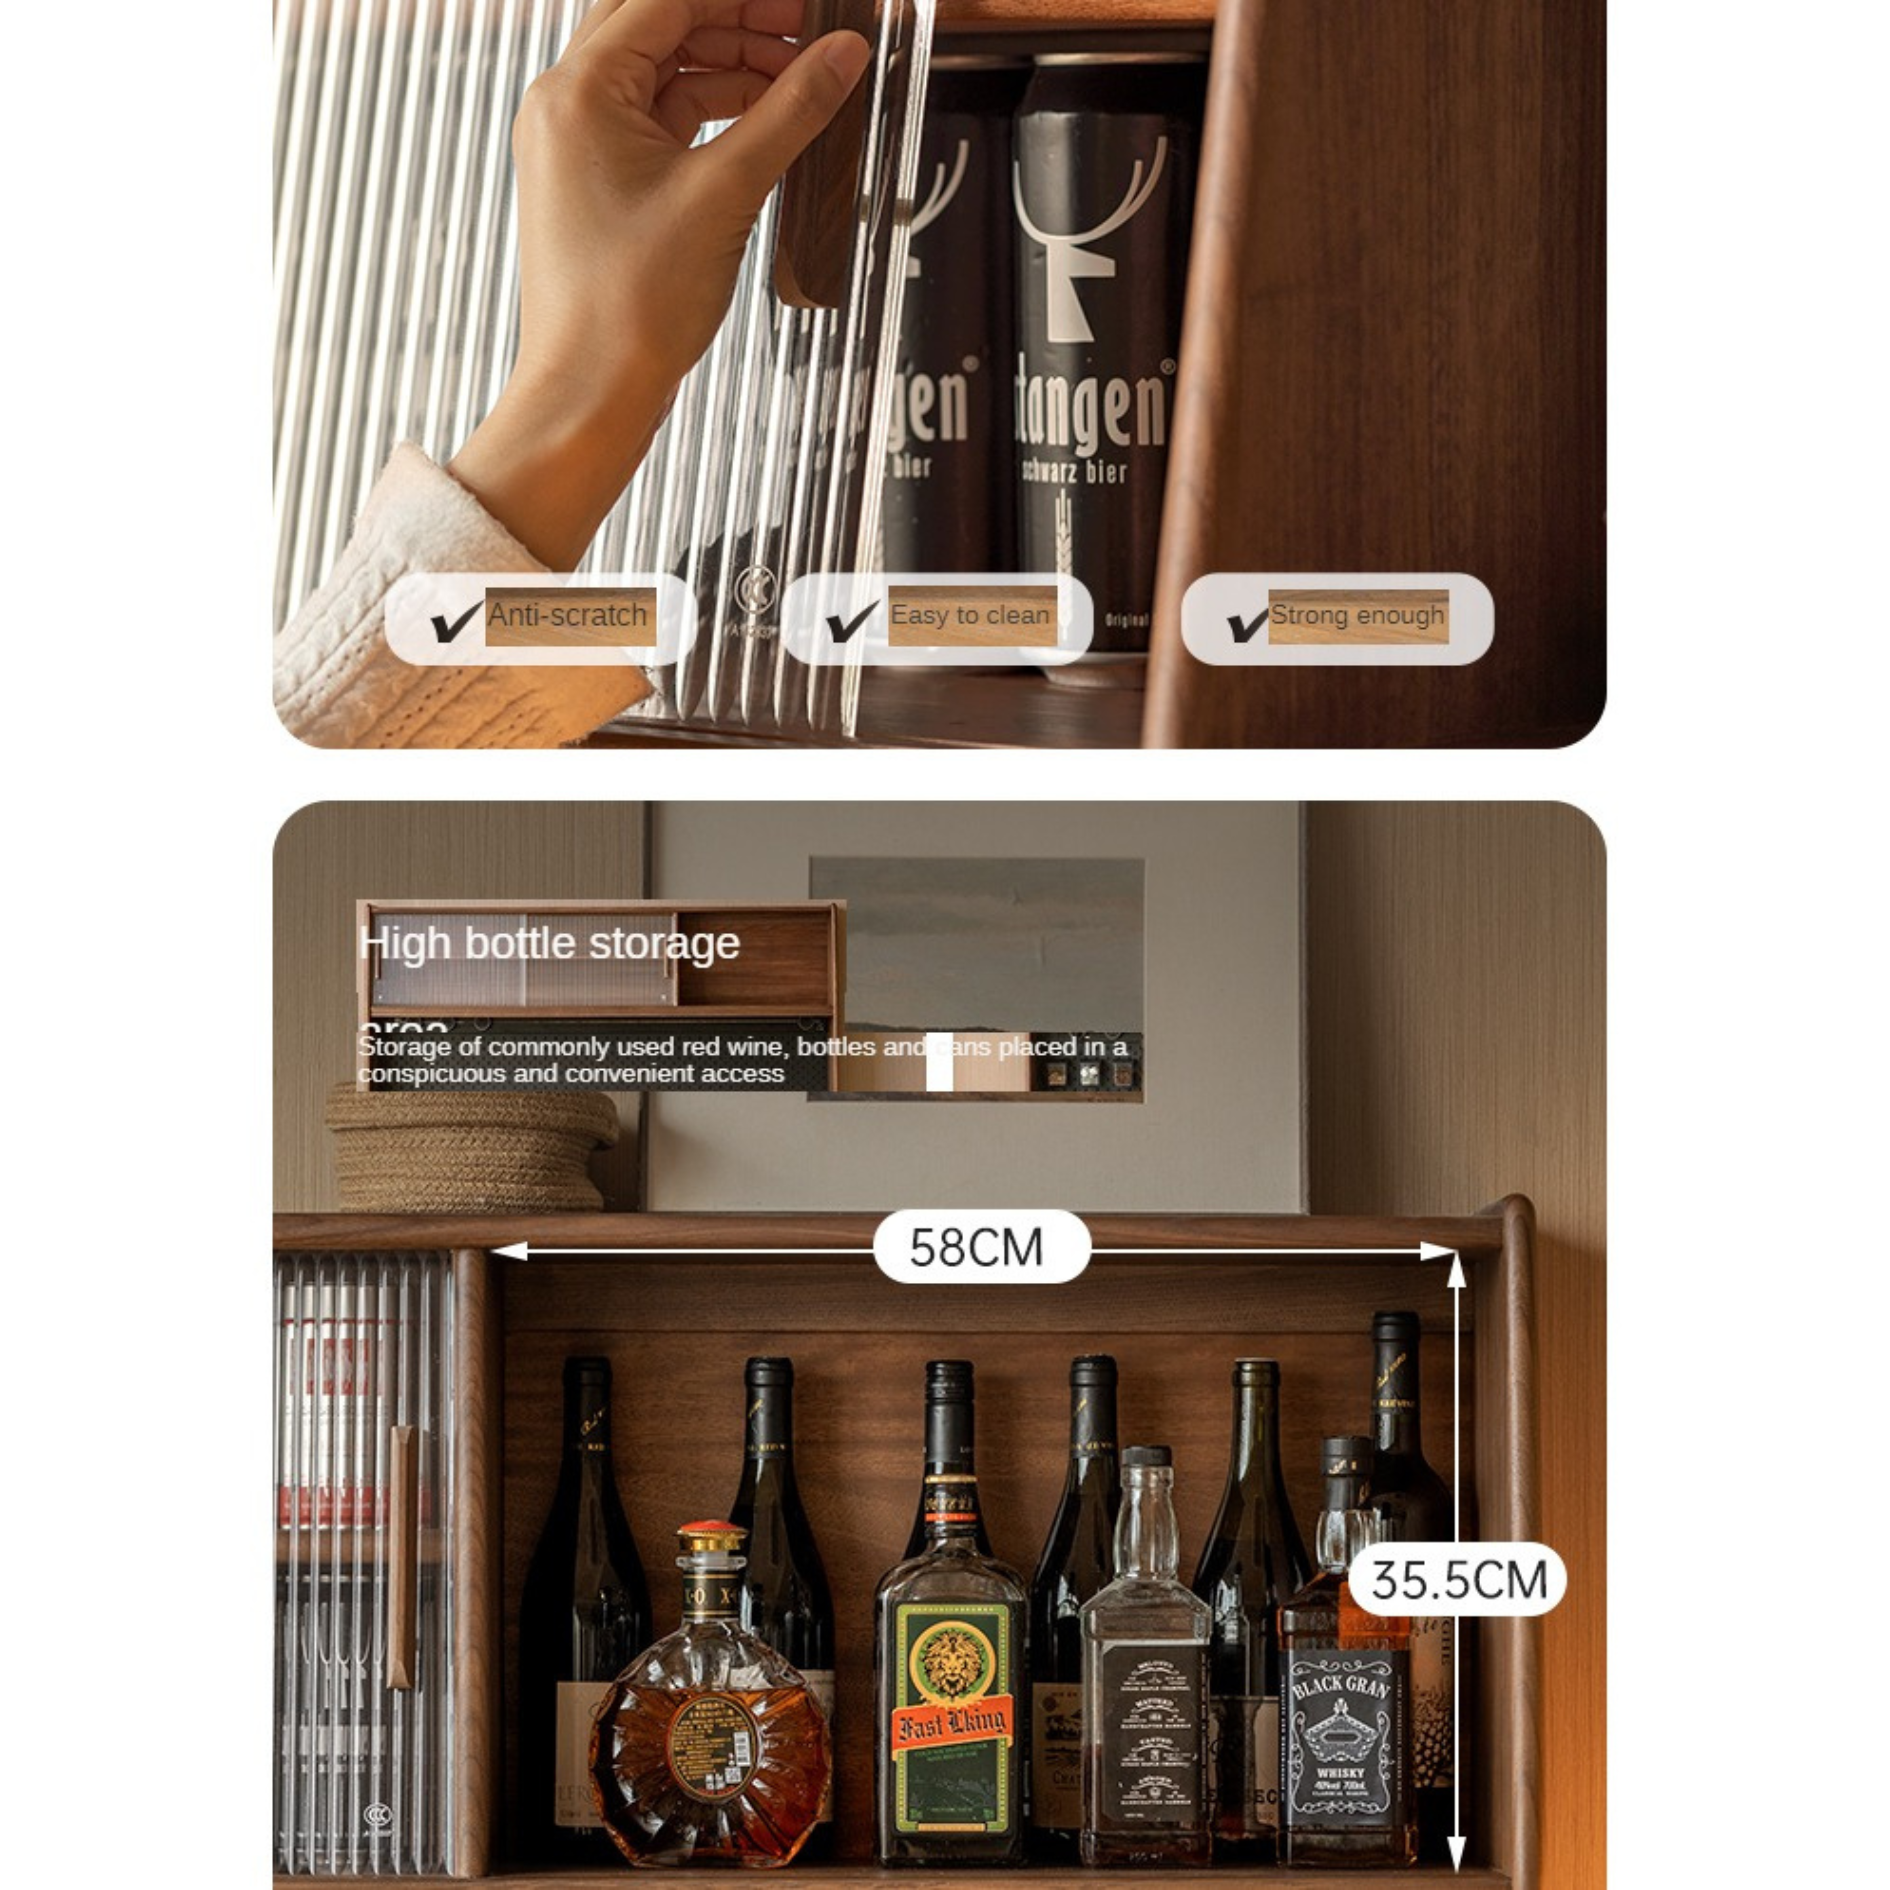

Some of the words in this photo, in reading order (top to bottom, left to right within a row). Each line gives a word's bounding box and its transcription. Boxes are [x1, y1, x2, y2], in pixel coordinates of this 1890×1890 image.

[1086, 459, 1127, 484] bier
[1292, 1675, 1342, 1700] BLACK
[1346, 1675, 1391, 1700] GRAN
[1316, 1767, 1365, 1779] WHISKY
